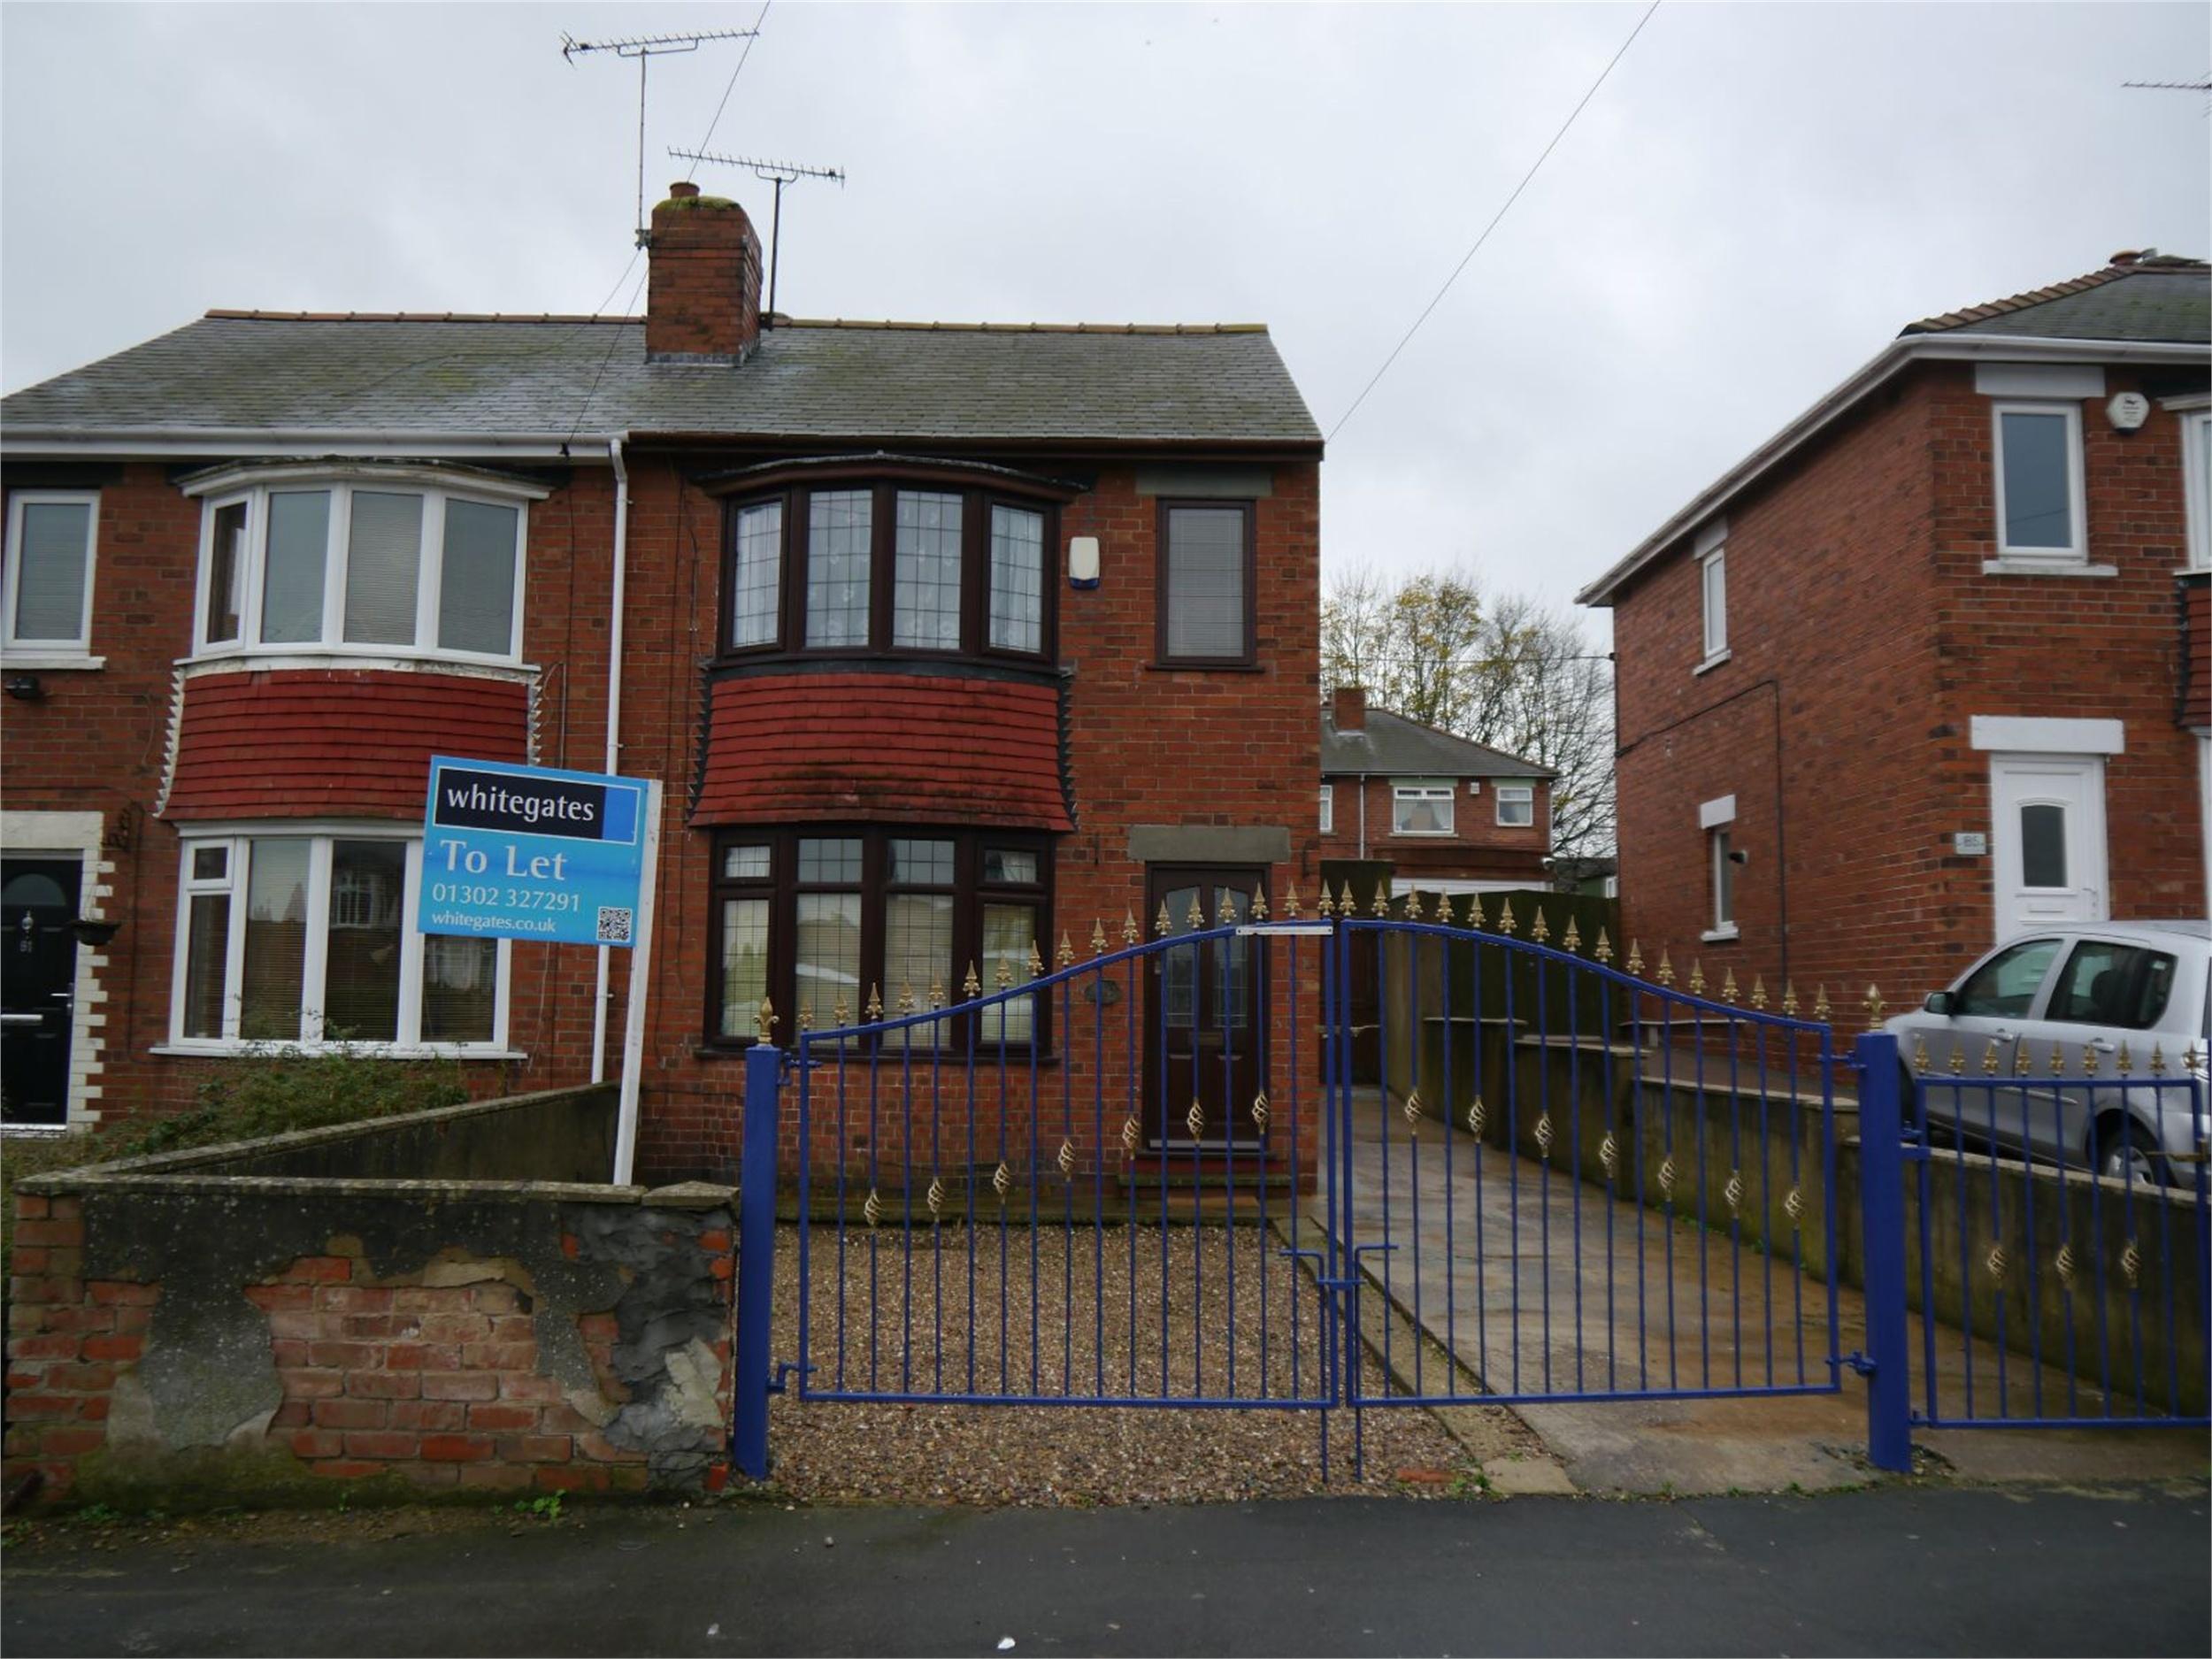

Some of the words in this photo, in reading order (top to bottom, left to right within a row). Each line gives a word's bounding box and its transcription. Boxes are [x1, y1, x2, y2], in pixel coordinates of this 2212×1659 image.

[447, 783, 594, 823] whitegates
[440, 839, 488, 873] To
[505, 845, 568, 880] Let
[432, 883, 498, 906] 01302
[505, 890, 580, 911] 327291
[432, 910, 556, 932] whitegates.co.uk
